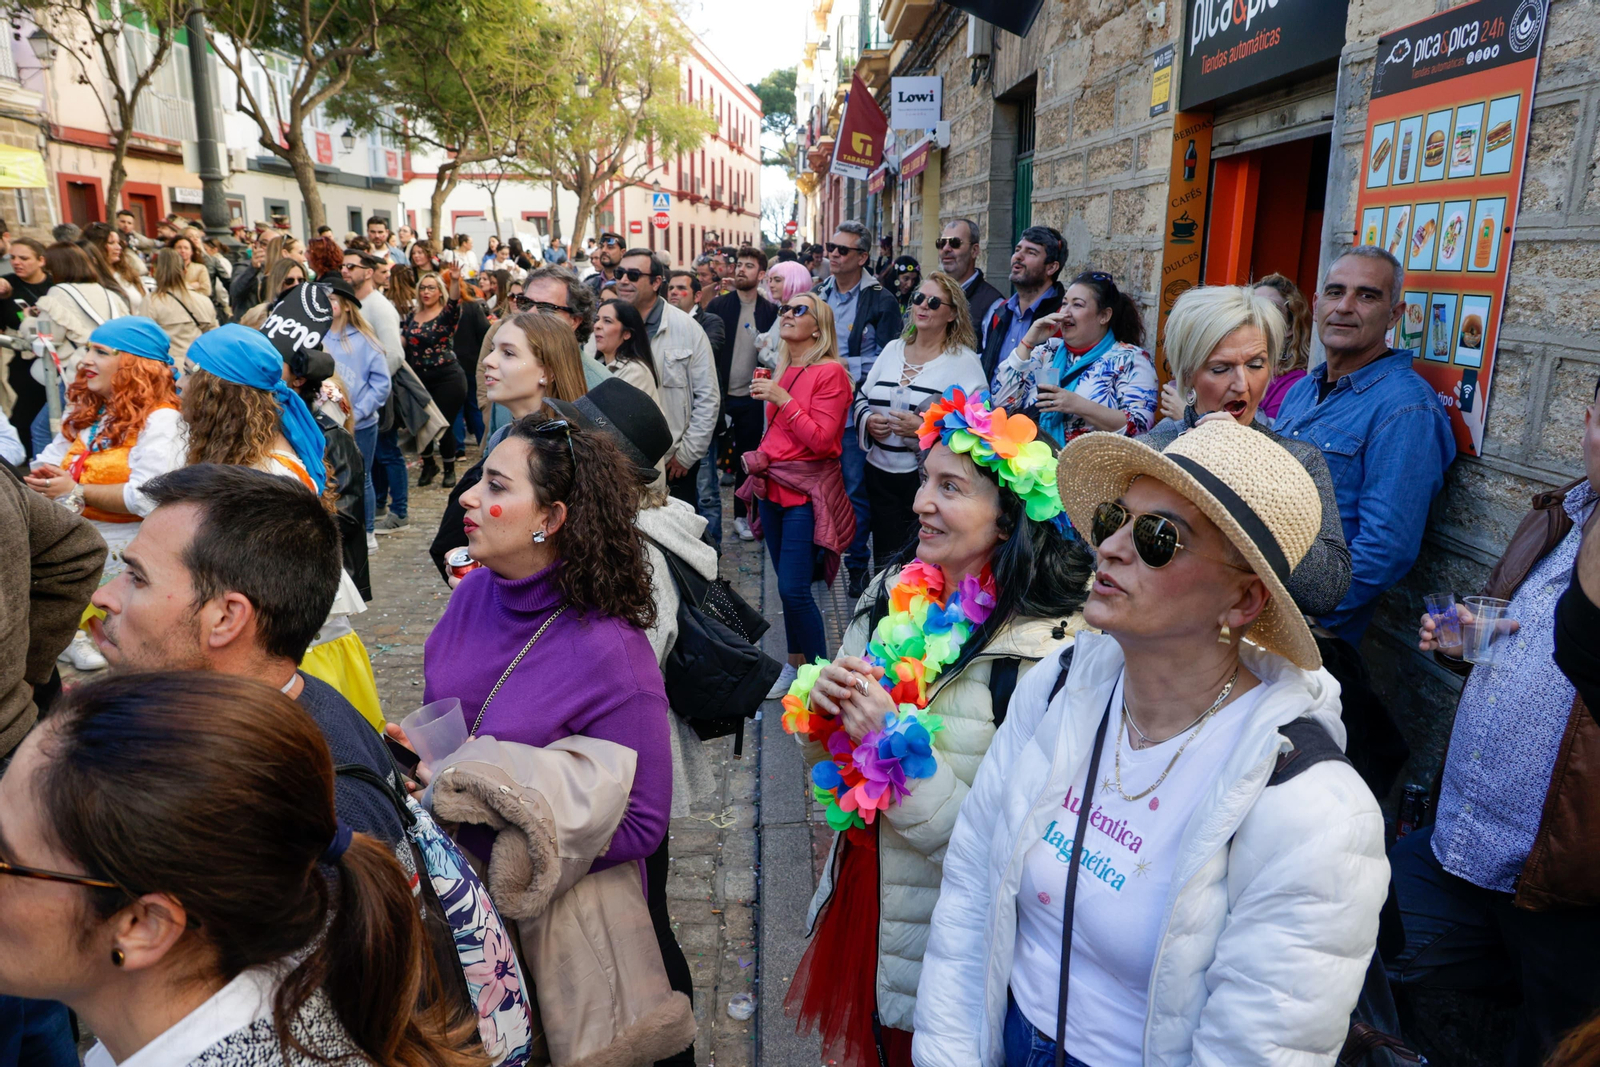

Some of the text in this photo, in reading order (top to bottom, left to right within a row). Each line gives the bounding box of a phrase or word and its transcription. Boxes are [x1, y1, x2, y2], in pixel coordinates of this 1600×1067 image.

[1201, 48, 1228, 75] Tiendas
[1228, 26, 1282, 64] automáticas
[1412, 20, 1480, 68] pica&pica
[1480, 16, 1505, 43] 24h
[898, 89, 935, 103] Lowi
[1173, 119, 1214, 142] BEBIDAS
[842, 153, 875, 167] TABACOS
[1171, 187, 1202, 208] CAFÉS
[653, 216, 669, 225] STOP
[1163, 251, 1200, 275] DULCES
